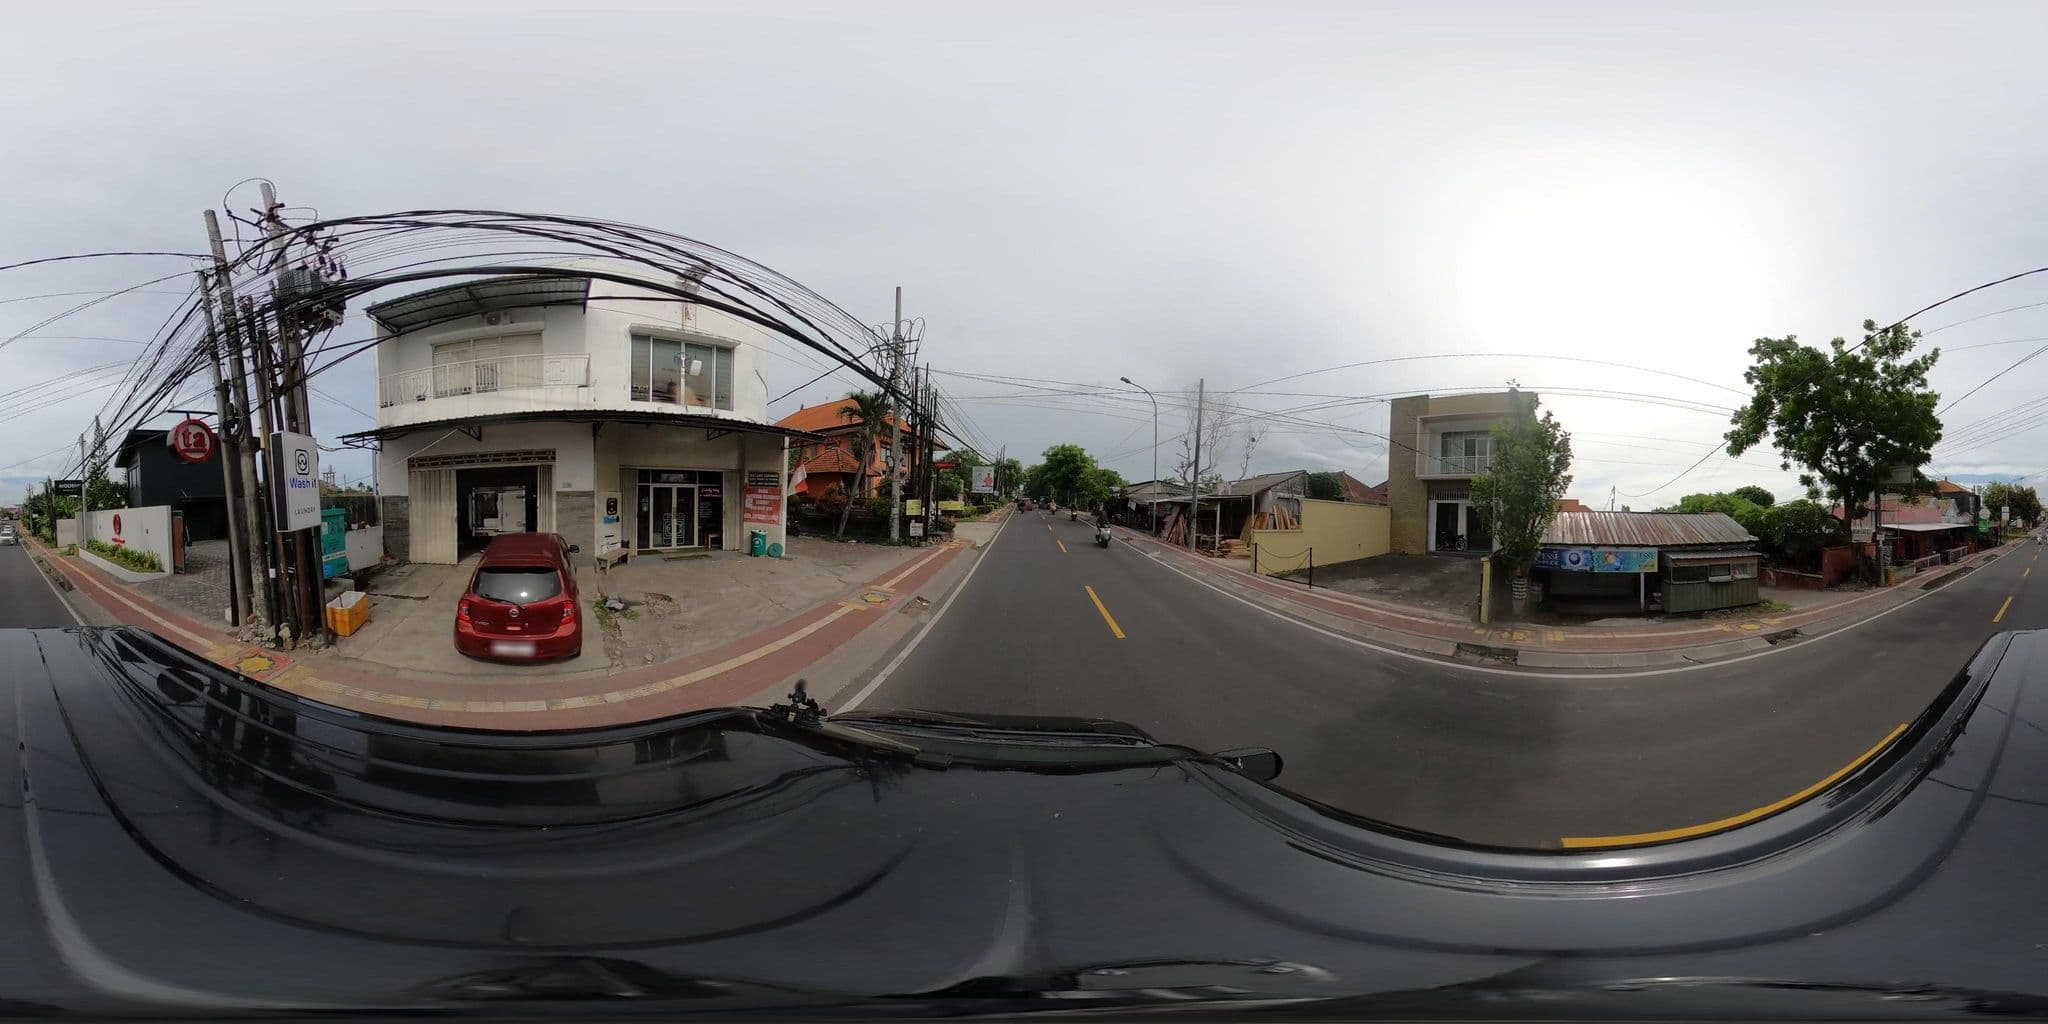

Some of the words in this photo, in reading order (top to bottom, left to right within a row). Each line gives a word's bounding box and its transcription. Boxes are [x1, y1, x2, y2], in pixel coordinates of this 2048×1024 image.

[289, 477, 311, 489] Wash
[311, 478, 317, 489] it
[294, 506, 316, 517] LAUNDRY
